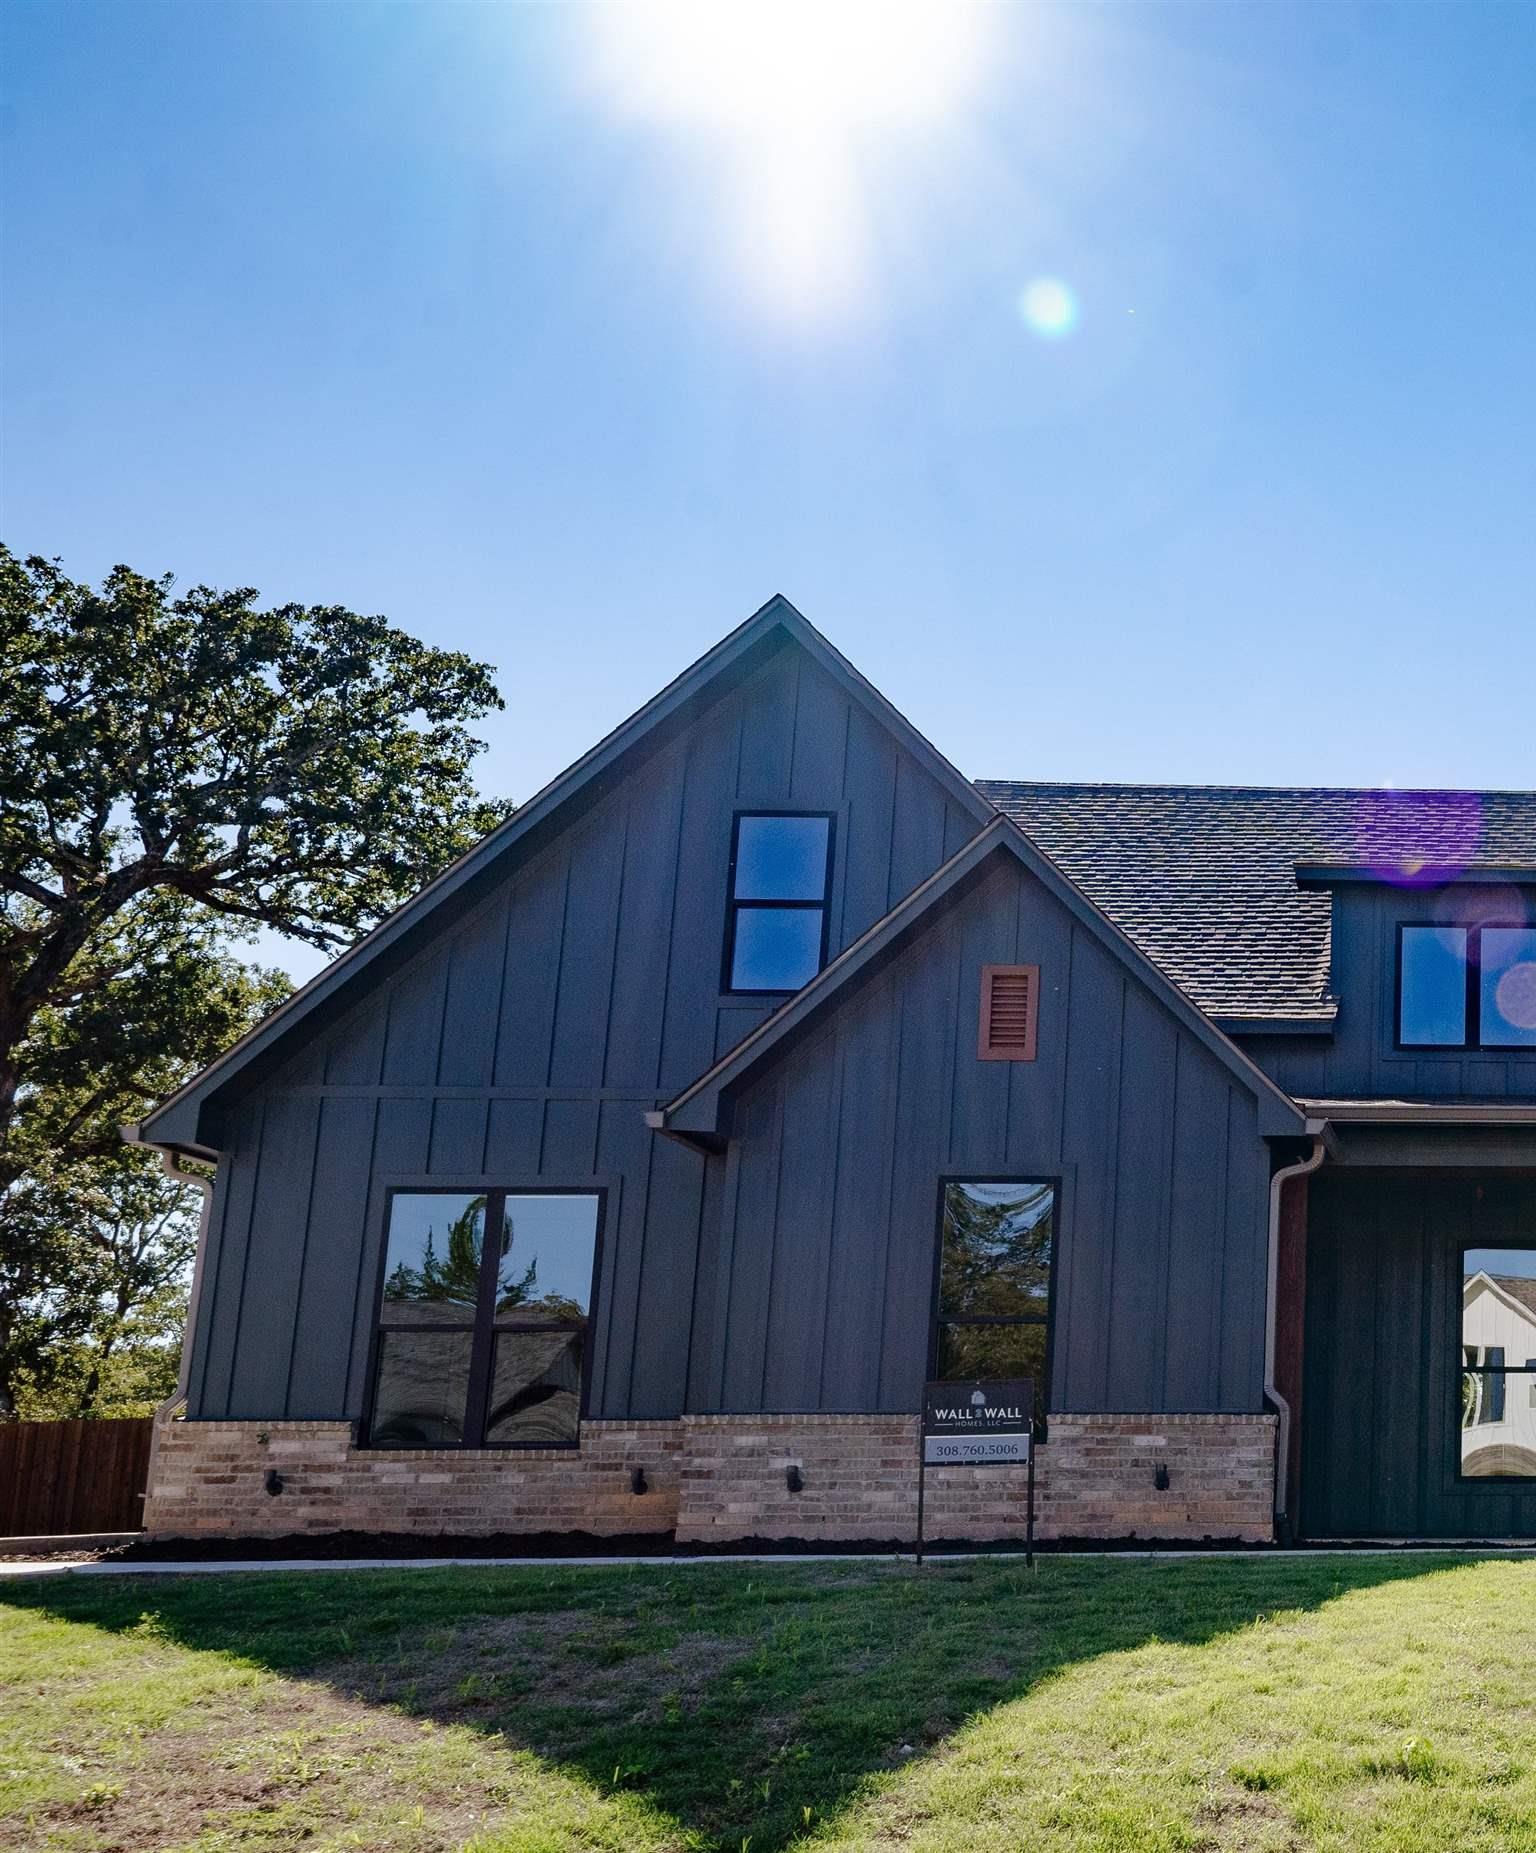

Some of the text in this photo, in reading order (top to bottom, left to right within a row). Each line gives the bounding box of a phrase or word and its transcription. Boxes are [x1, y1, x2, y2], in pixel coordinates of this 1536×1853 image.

[935, 1409, 973, 1420] WALL
[984, 1407, 1022, 1419] WALL
[936, 1444, 1018, 1457] 308.760.5006
